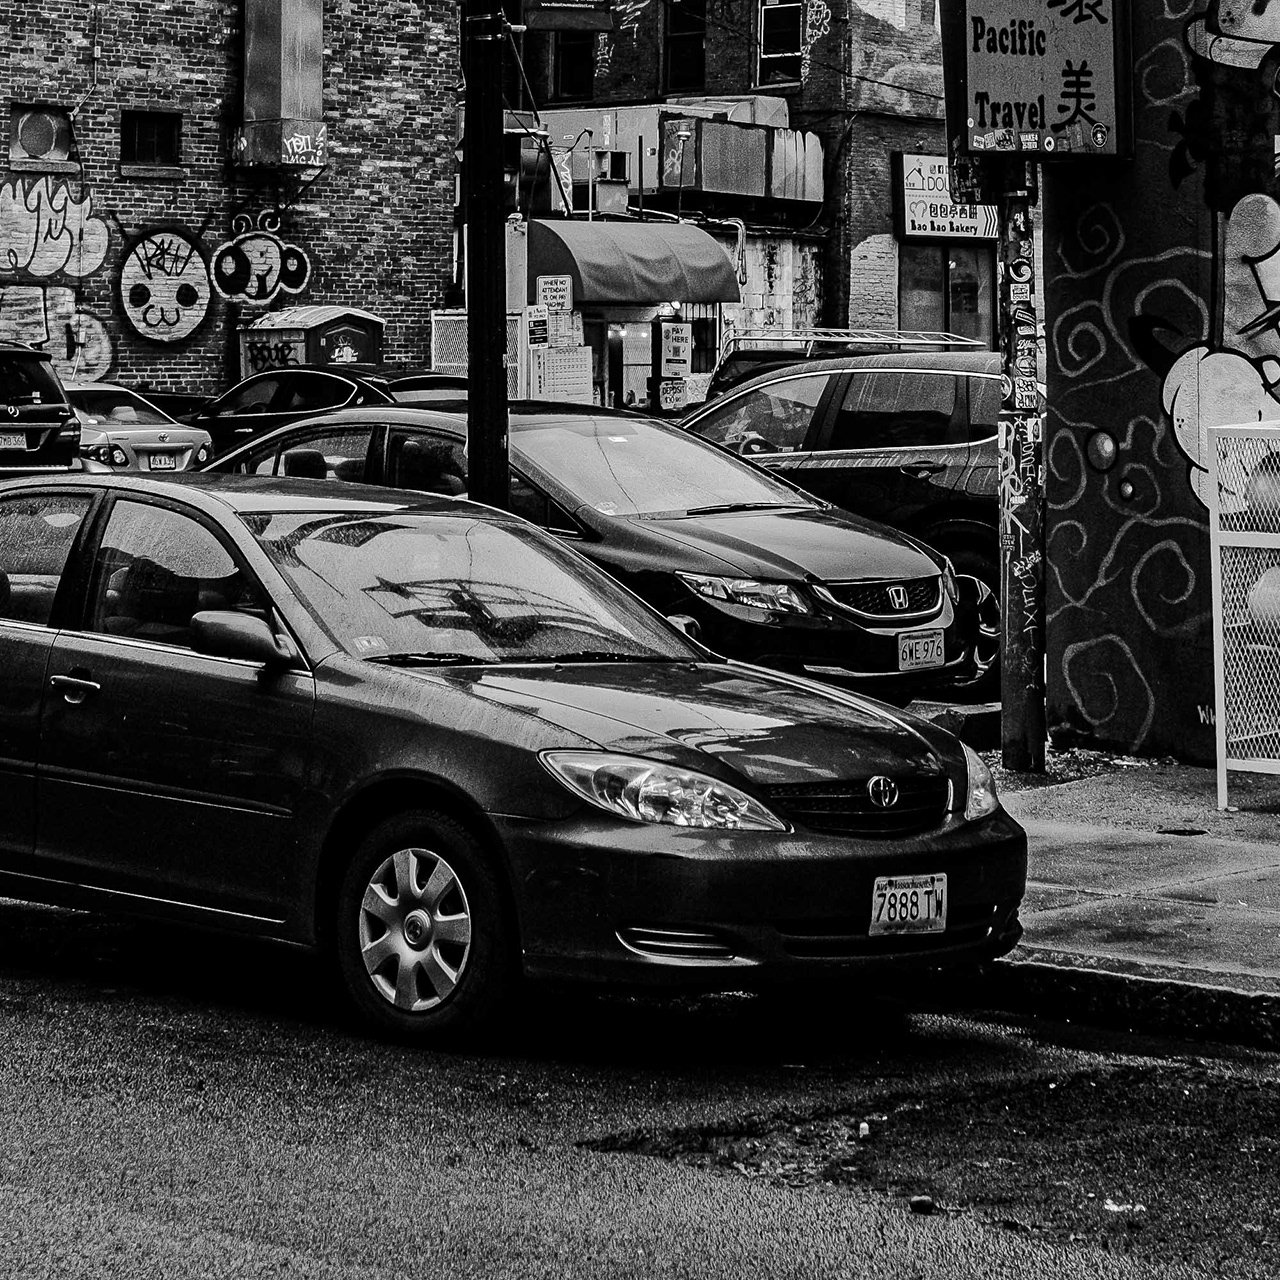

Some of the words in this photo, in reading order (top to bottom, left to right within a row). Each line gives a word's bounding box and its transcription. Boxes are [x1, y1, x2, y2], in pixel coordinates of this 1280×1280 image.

[971, 16, 1047, 57] Pacific
[975, 91, 1047, 130] Travel
[910, 219, 927, 231] Bao
[930, 220, 947, 232] Bao
[949, 220, 979, 236] Bakery
[671, 327, 685, 335] PAY
[671, 336, 689, 344] HERE
[923, 638, 943, 659] 976
[876, 890, 919, 923] 7888
[923, 888, 944, 920] TW
